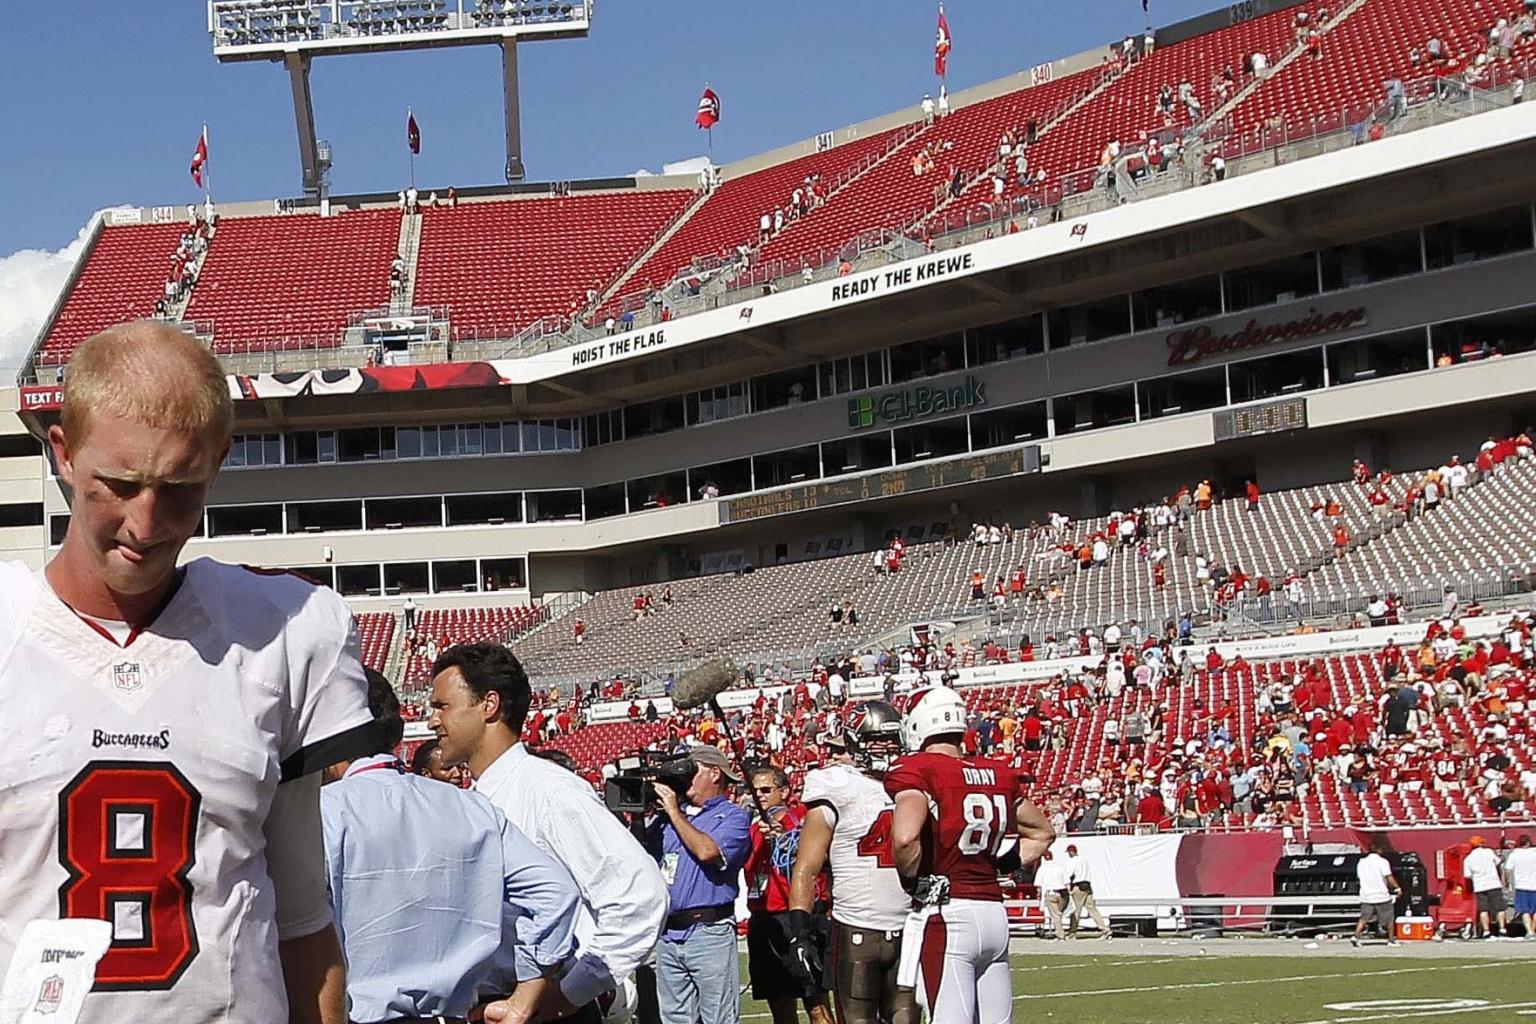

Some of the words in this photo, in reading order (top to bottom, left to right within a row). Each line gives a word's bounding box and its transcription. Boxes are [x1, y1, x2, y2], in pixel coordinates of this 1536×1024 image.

[276, 198, 294, 214] 343
[832, 275, 879, 301] READY
[885, 268, 912, 288] THE
[916, 253, 975, 281] KREWE.
[573, 345, 605, 366] HOIST
[609, 338, 630, 356] THE
[634, 330, 667, 351] FLAG.
[1167, 307, 1368, 366] Budweiser
[24, 391, 52, 405] TEXT
[913, 375, 985, 416] Bank
[1236, 403, 1302, 433] 0:00
[117, 673, 138, 686] NFL
[962, 767, 996, 786] DRAY
[958, 793, 1007, 855] 81
[59, 760, 202, 992] 8
